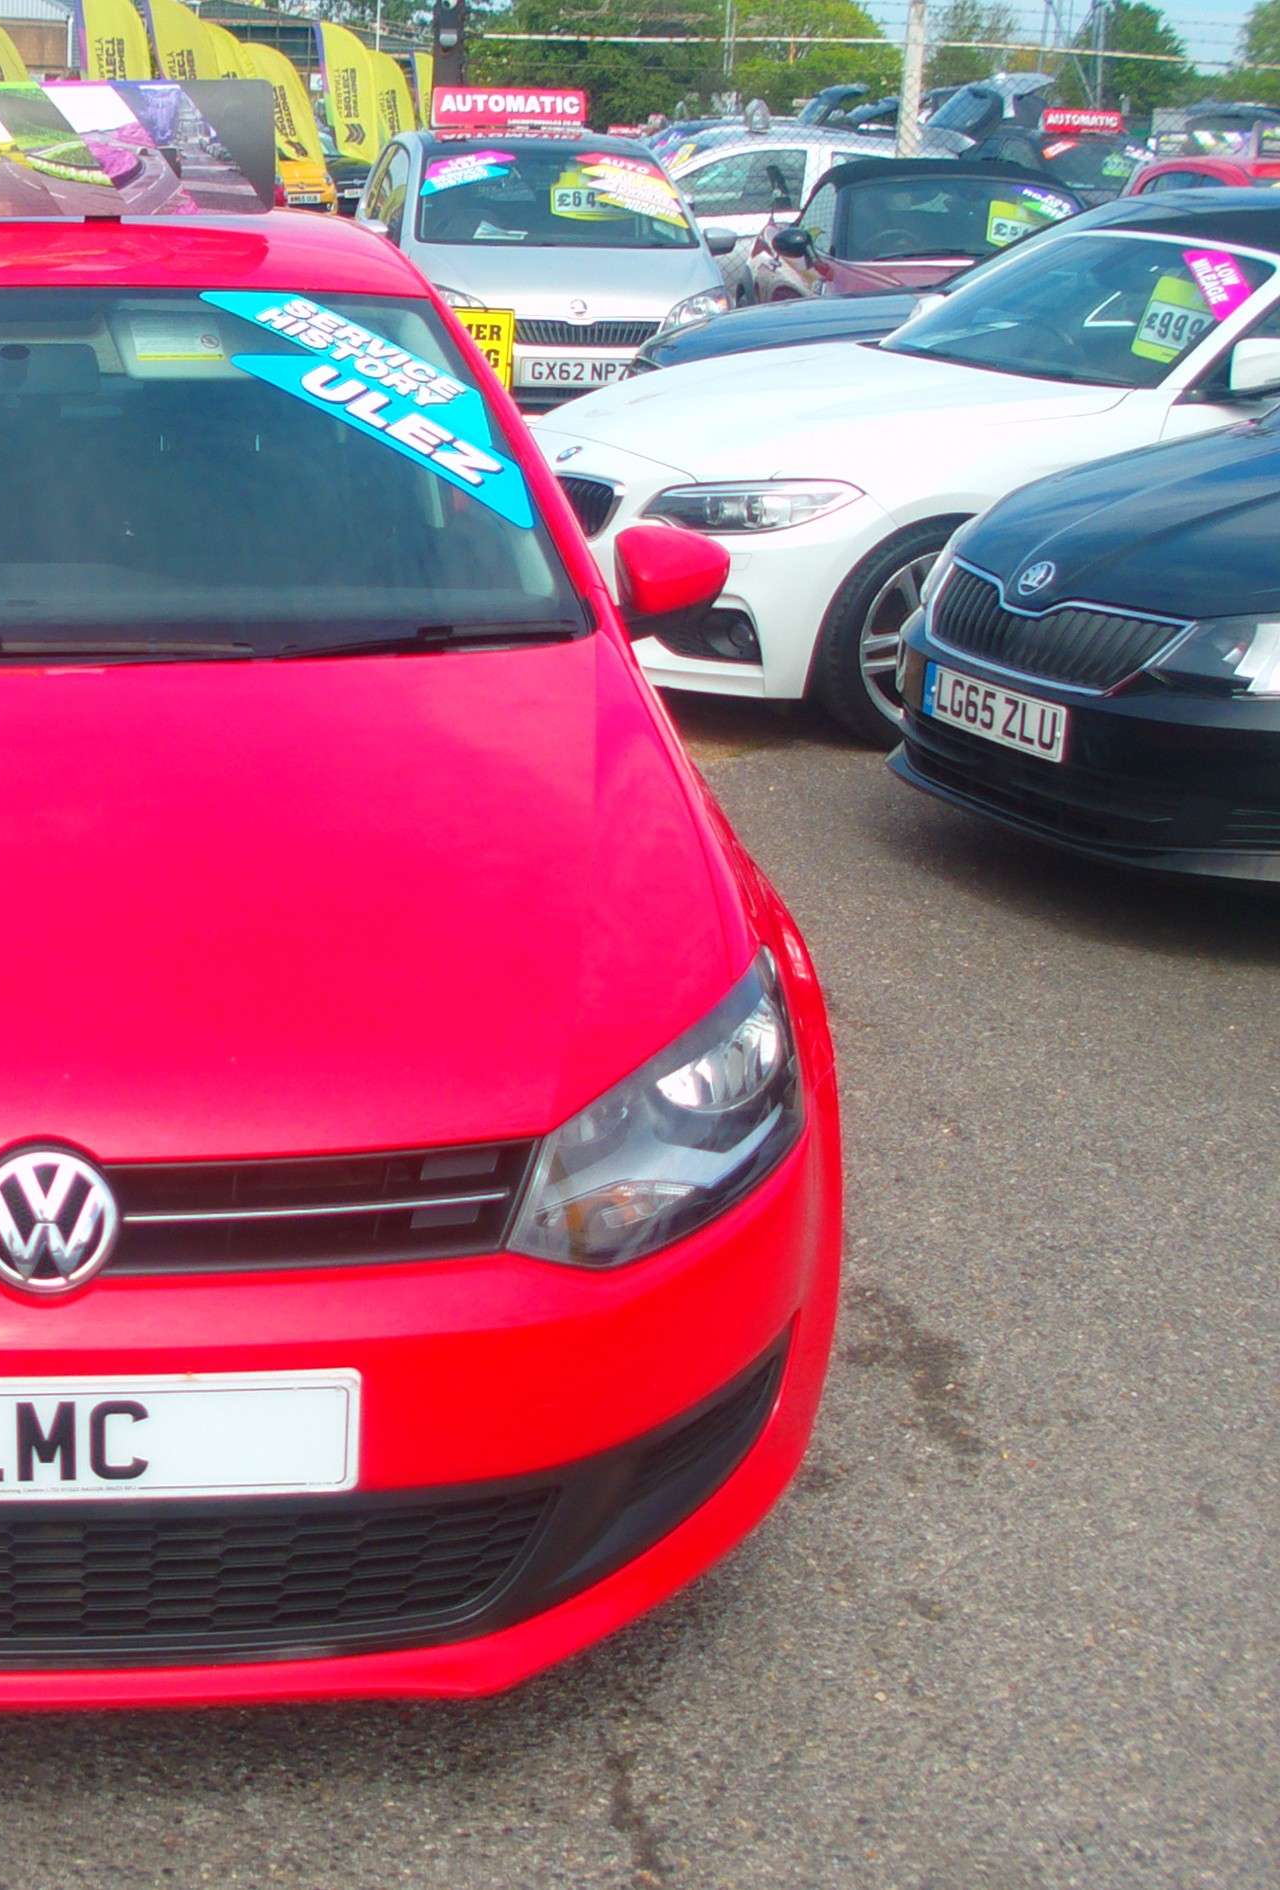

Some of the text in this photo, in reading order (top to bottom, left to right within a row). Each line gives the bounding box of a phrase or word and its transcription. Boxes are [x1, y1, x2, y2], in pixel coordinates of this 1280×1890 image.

[440, 94, 580, 114] AUTOMATIC
[1046, 113, 1119, 127] AUTOMATIC
[600, 156, 650, 174] AUTO
[1191, 258, 1230, 305] MILEAGE
[1214, 262, 1241, 286] LOW
[255, 307, 452, 408] HISTORY
[282, 298, 467, 403] SERVICE
[531, 362, 584, 381] GX62
[300, 363, 504, 486] ULEZ
[936, 672, 1058, 751] LG65 ZLU
